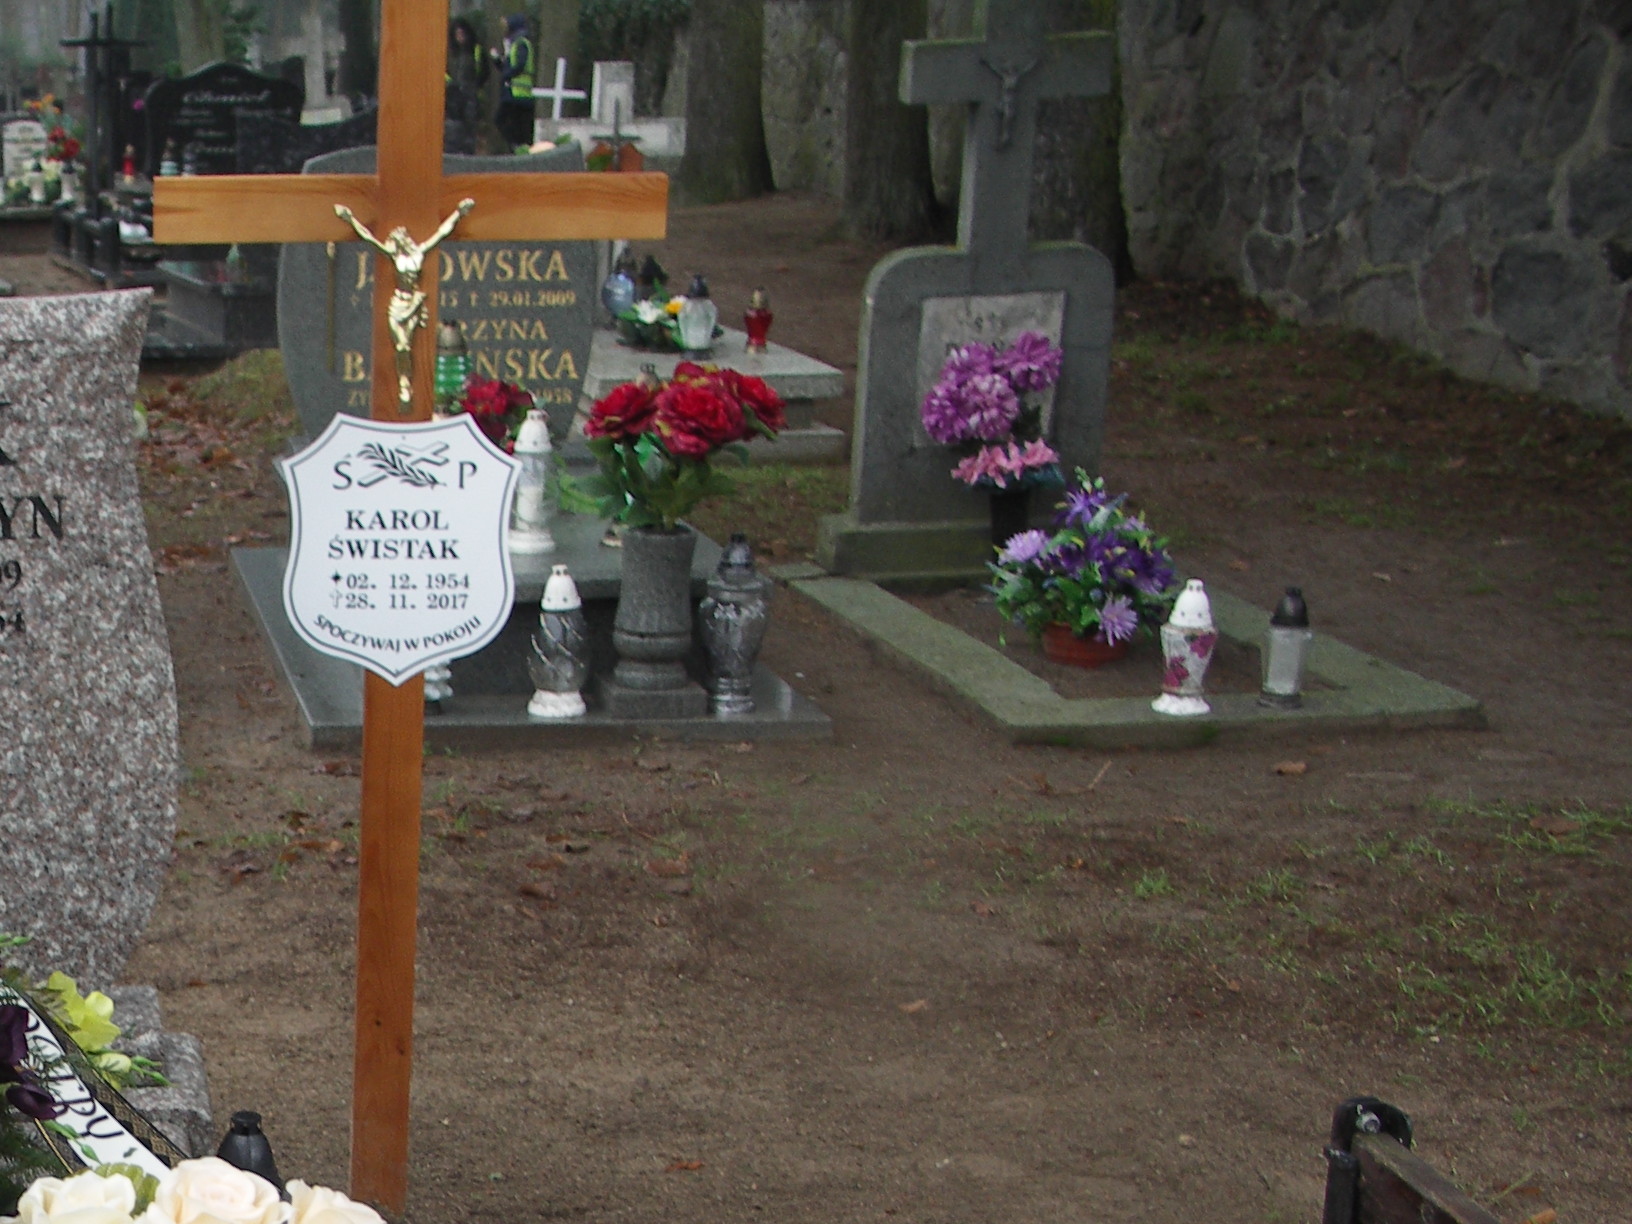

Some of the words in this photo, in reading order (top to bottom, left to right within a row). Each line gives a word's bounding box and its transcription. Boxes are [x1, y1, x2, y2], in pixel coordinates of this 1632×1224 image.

[458, 461, 478, 489] P
[345, 509, 449, 531] KAROL
[327, 534, 461, 560] ŚWISTAK
[425, 573, 471, 590] 1954
[426, 593, 469, 610] 2017
[313, 614, 402, 653] SPOCZYWAJ
[403, 636, 420, 651] W
[422, 614, 482, 648] POKOJU
